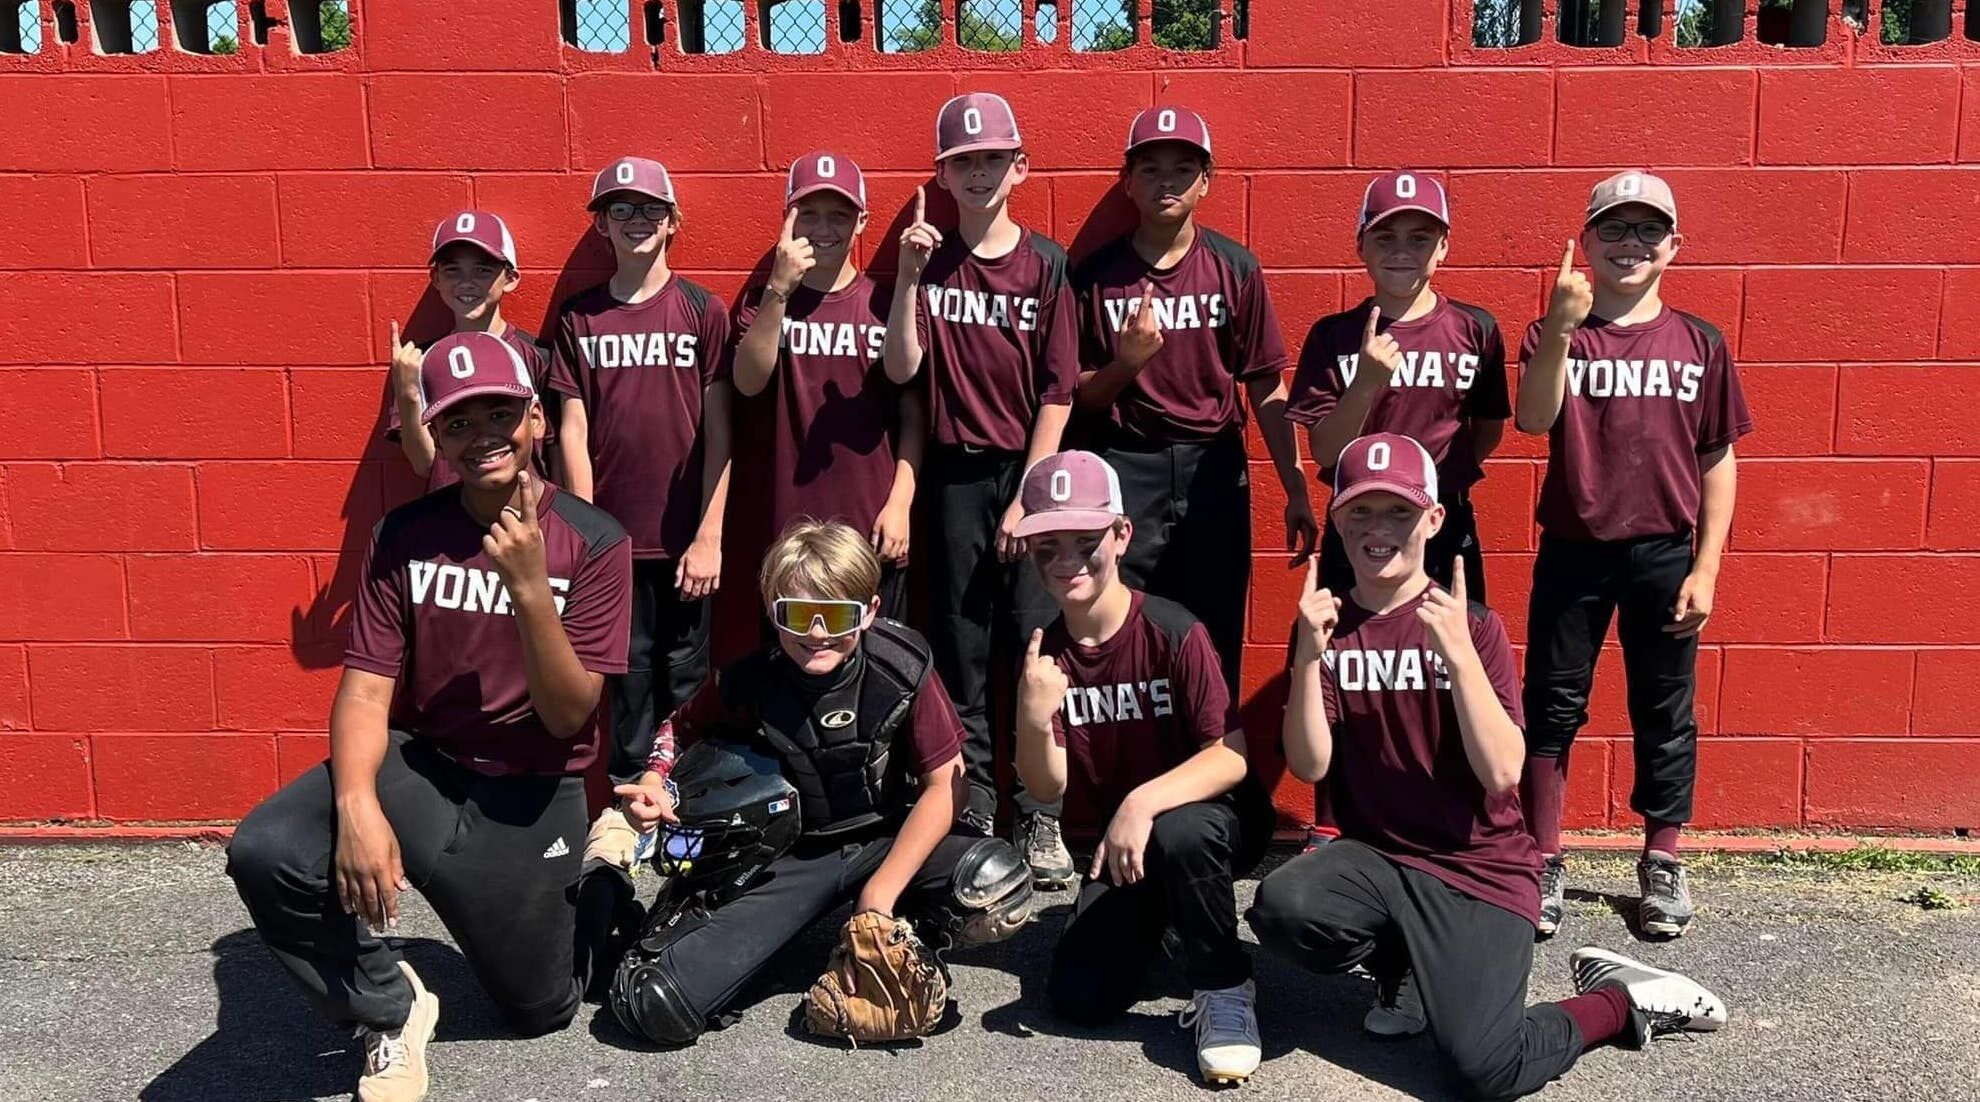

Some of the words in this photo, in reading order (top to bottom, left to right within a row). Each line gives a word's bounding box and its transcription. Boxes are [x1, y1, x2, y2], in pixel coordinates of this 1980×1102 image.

[963, 107, 984, 135] O
[1158, 109, 1177, 132] O
[616, 162, 635, 185] O
[816, 155, 836, 178] O
[1396, 174, 1417, 199] O
[1616, 174, 1641, 197] O
[455, 212, 475, 234] O
[927, 284, 1039, 331] VONA'S
[1104, 294, 1227, 332] VNA'S
[448, 345, 476, 380] O
[579, 332, 699, 370] VONA'S
[1337, 351, 1480, 390] VNA'S
[1566, 359, 1705, 402] VONA'S
[1366, 441, 1392, 471] O
[1050, 469, 1072, 501] O
[1060, 678, 1173, 727] ONA'S
